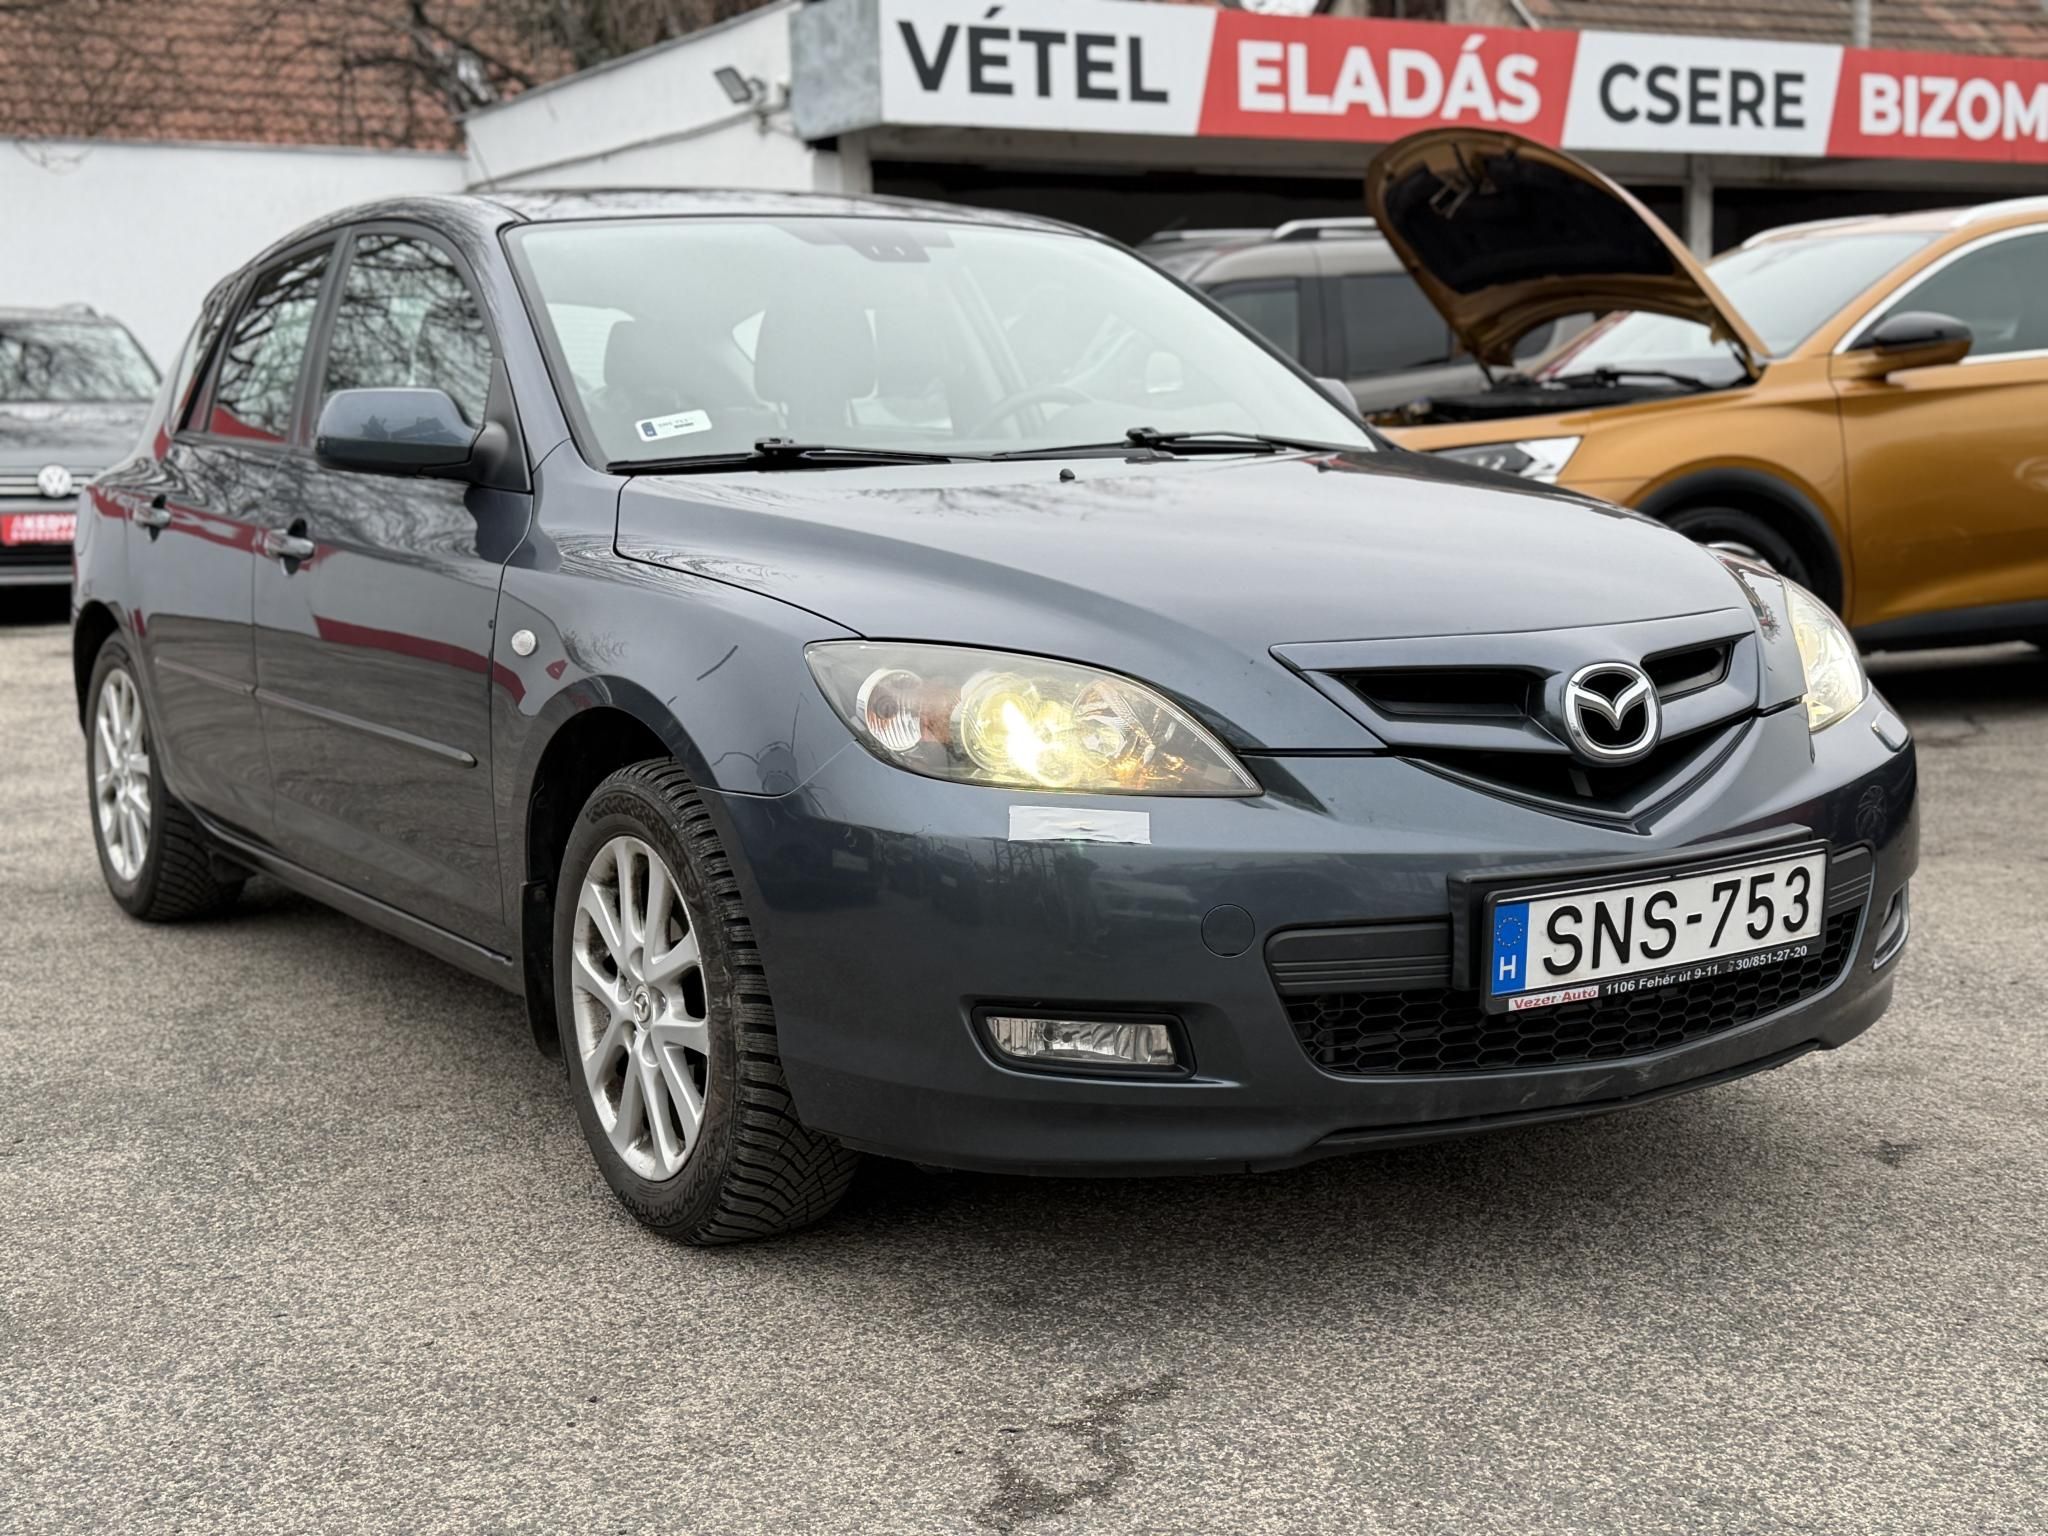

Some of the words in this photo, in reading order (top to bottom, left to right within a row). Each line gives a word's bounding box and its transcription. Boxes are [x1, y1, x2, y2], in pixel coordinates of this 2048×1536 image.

[898, 6, 1169, 103] VÉTEL
[1237, 33, 1541, 124] ELADÁS
[1598, 62, 1806, 129] CSERE
[1859, 72, 2048, 143] BIZOM
[1499, 954, 1517, 981] H
[1543, 865, 1811, 976] SNS-753
[1605, 980, 1635, 995] 1106
[1638, 974, 1675, 990] Fehér
[1735, 945, 1808, 971] 30/851-27-20
